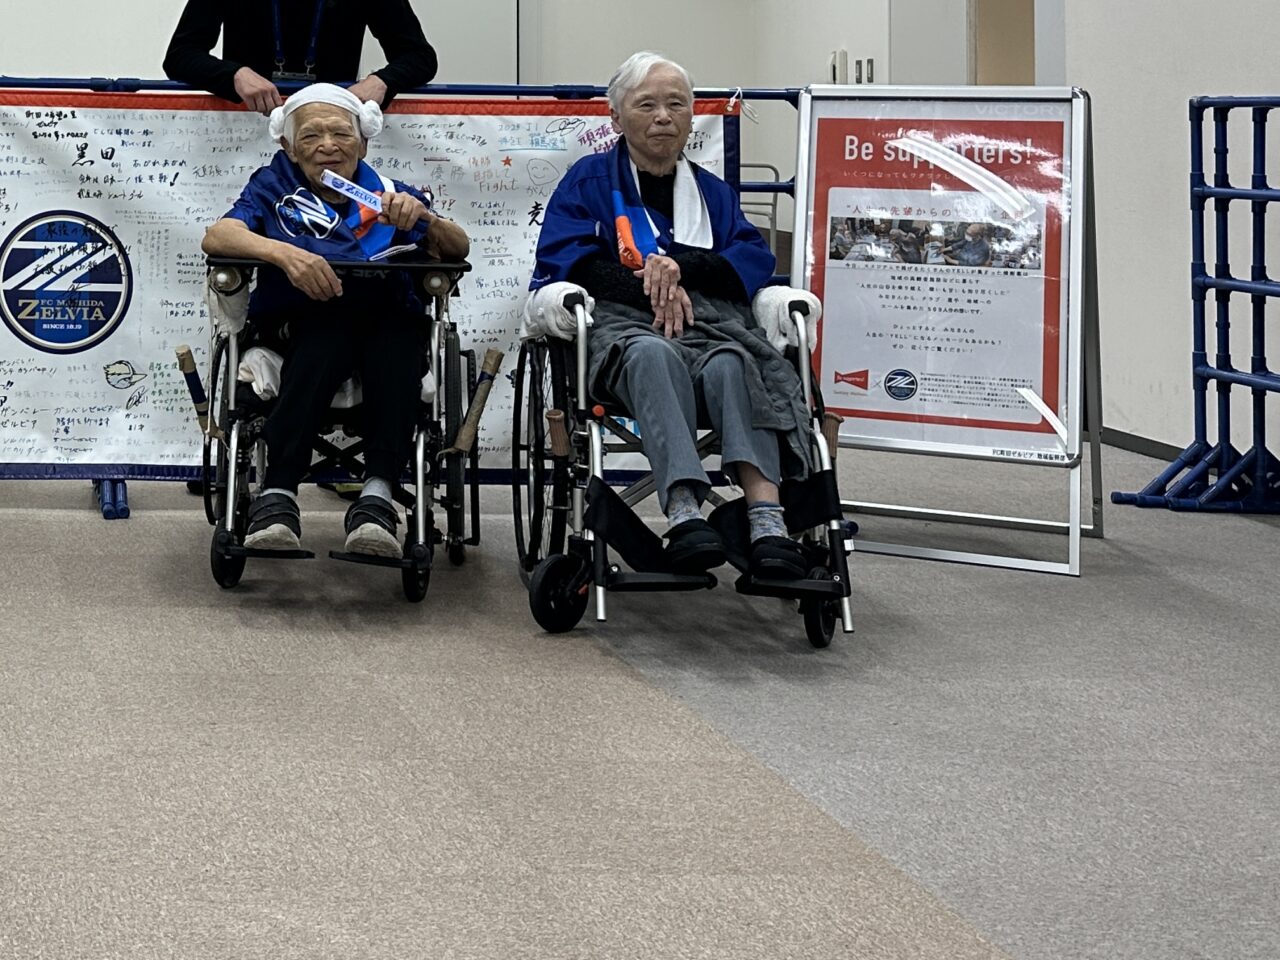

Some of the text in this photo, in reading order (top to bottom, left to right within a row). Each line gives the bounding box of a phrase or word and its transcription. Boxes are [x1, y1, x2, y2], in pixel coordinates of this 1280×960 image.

[844, 135, 1032, 169] Be suprters!
[345, 183, 377, 207] ZELVIA
[479, 179, 519, 193] Fight
[17, 299, 106, 321] ZELVIA
[56, 299, 105, 307] MHIDA
